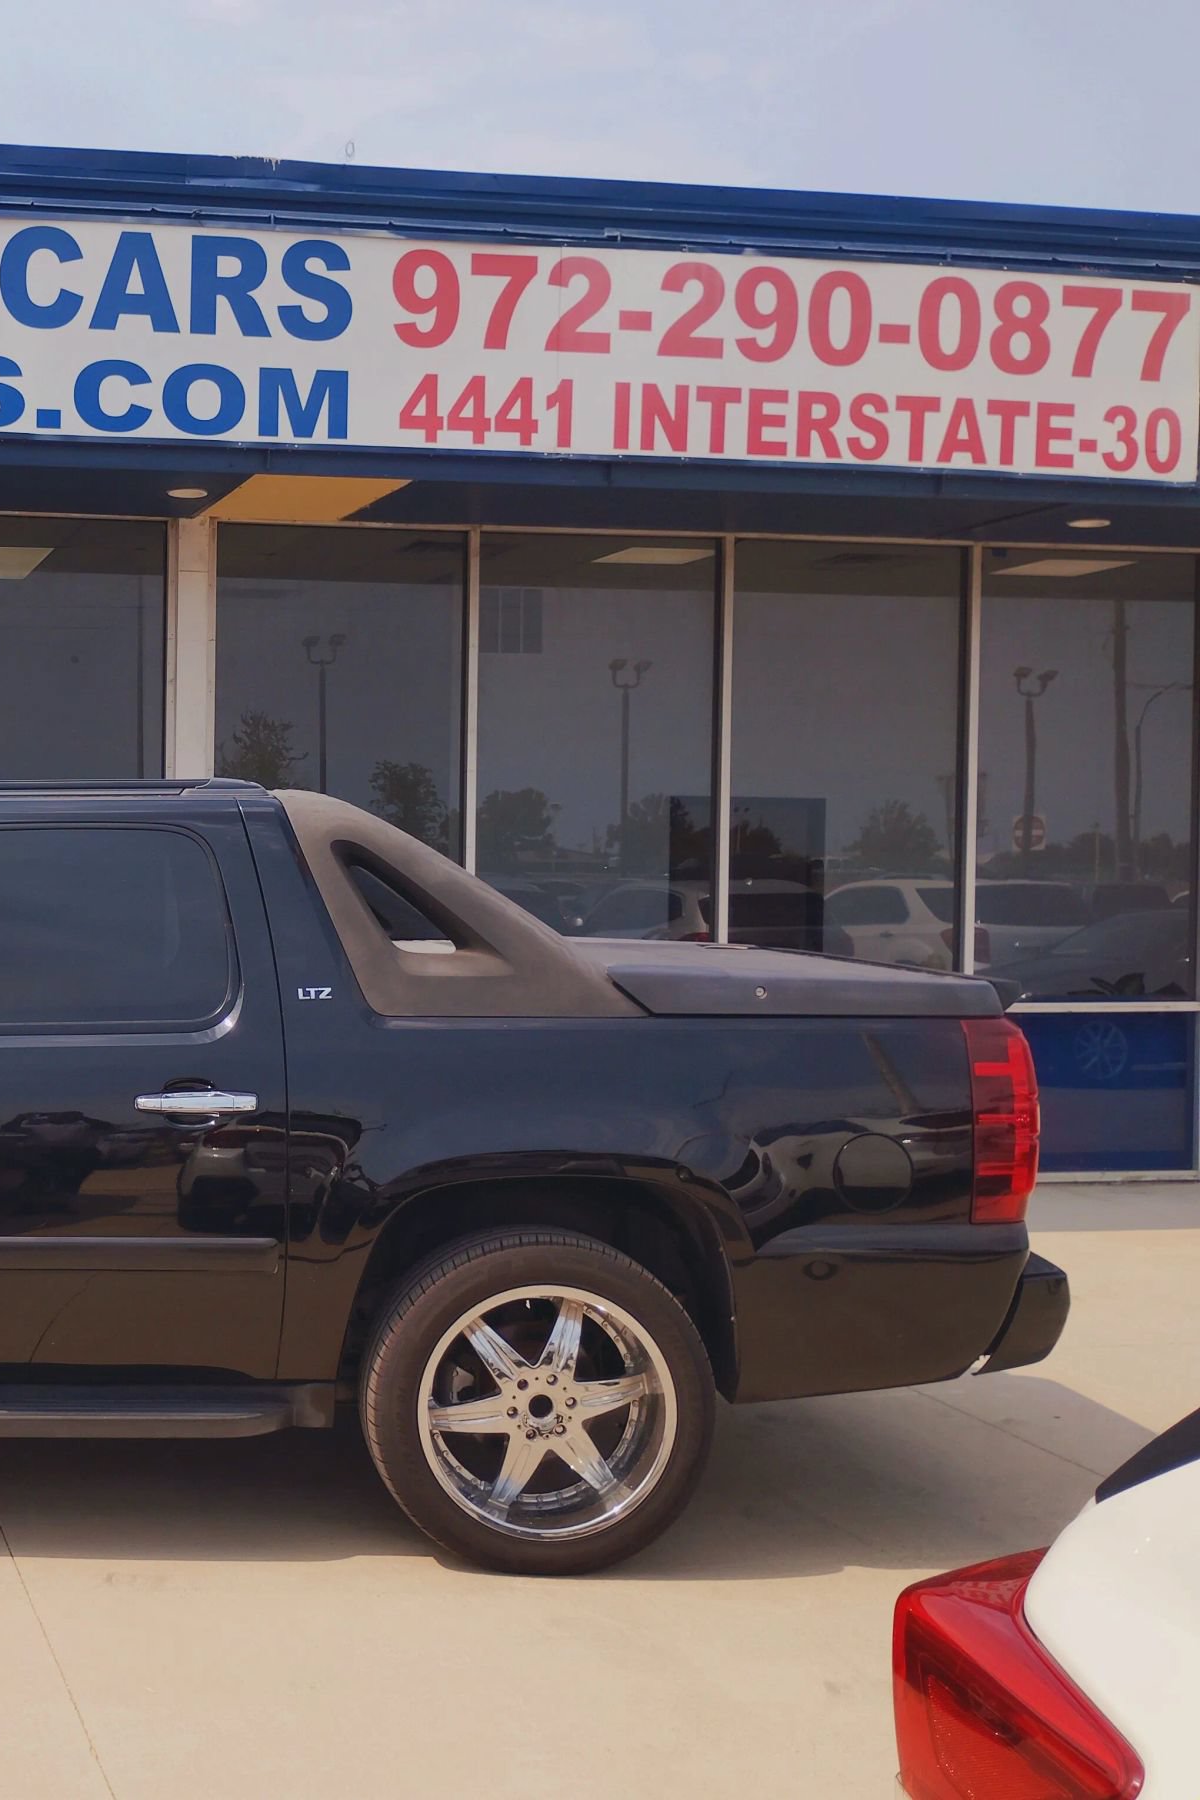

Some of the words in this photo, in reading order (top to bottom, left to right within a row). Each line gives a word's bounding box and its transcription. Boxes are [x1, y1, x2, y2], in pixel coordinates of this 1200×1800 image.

[0, 226, 353, 341] CARS
[392, 248, 1191, 382] 972-290-0877
[399, 372, 574, 449] 4441
[613, 382, 1182, 475] INTERSTATE-30
[297, 987, 332, 1000] LTZ
